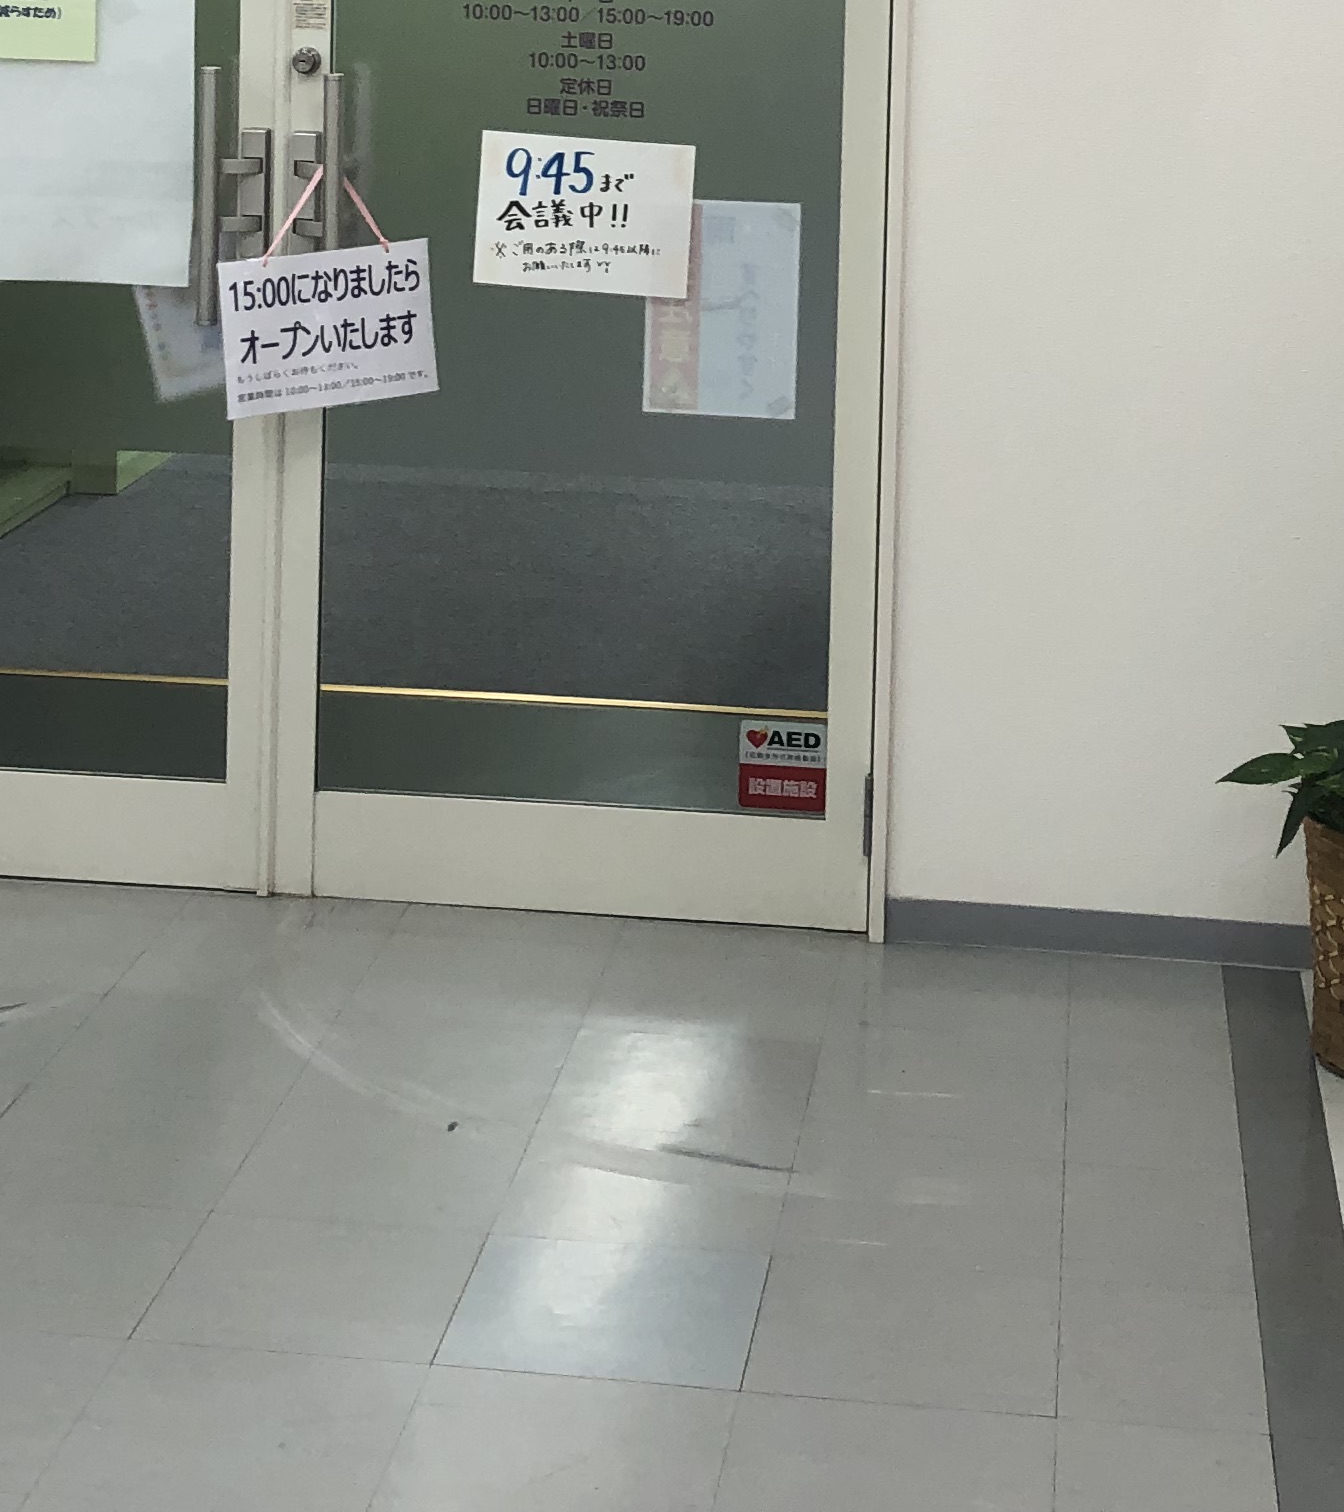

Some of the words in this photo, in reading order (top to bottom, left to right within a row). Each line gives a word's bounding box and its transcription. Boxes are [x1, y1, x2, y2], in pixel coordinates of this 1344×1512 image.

[560, 32, 613, 51] 土曜日
[559, 78, 613, 97] 定休日
[526, 98, 646, 119] 日曜日・祝祭日
[228, 259, 421, 312] 15:00になりましたら
[240, 310, 418, 364] オープンいたします
[767, 730, 821, 748] AED
